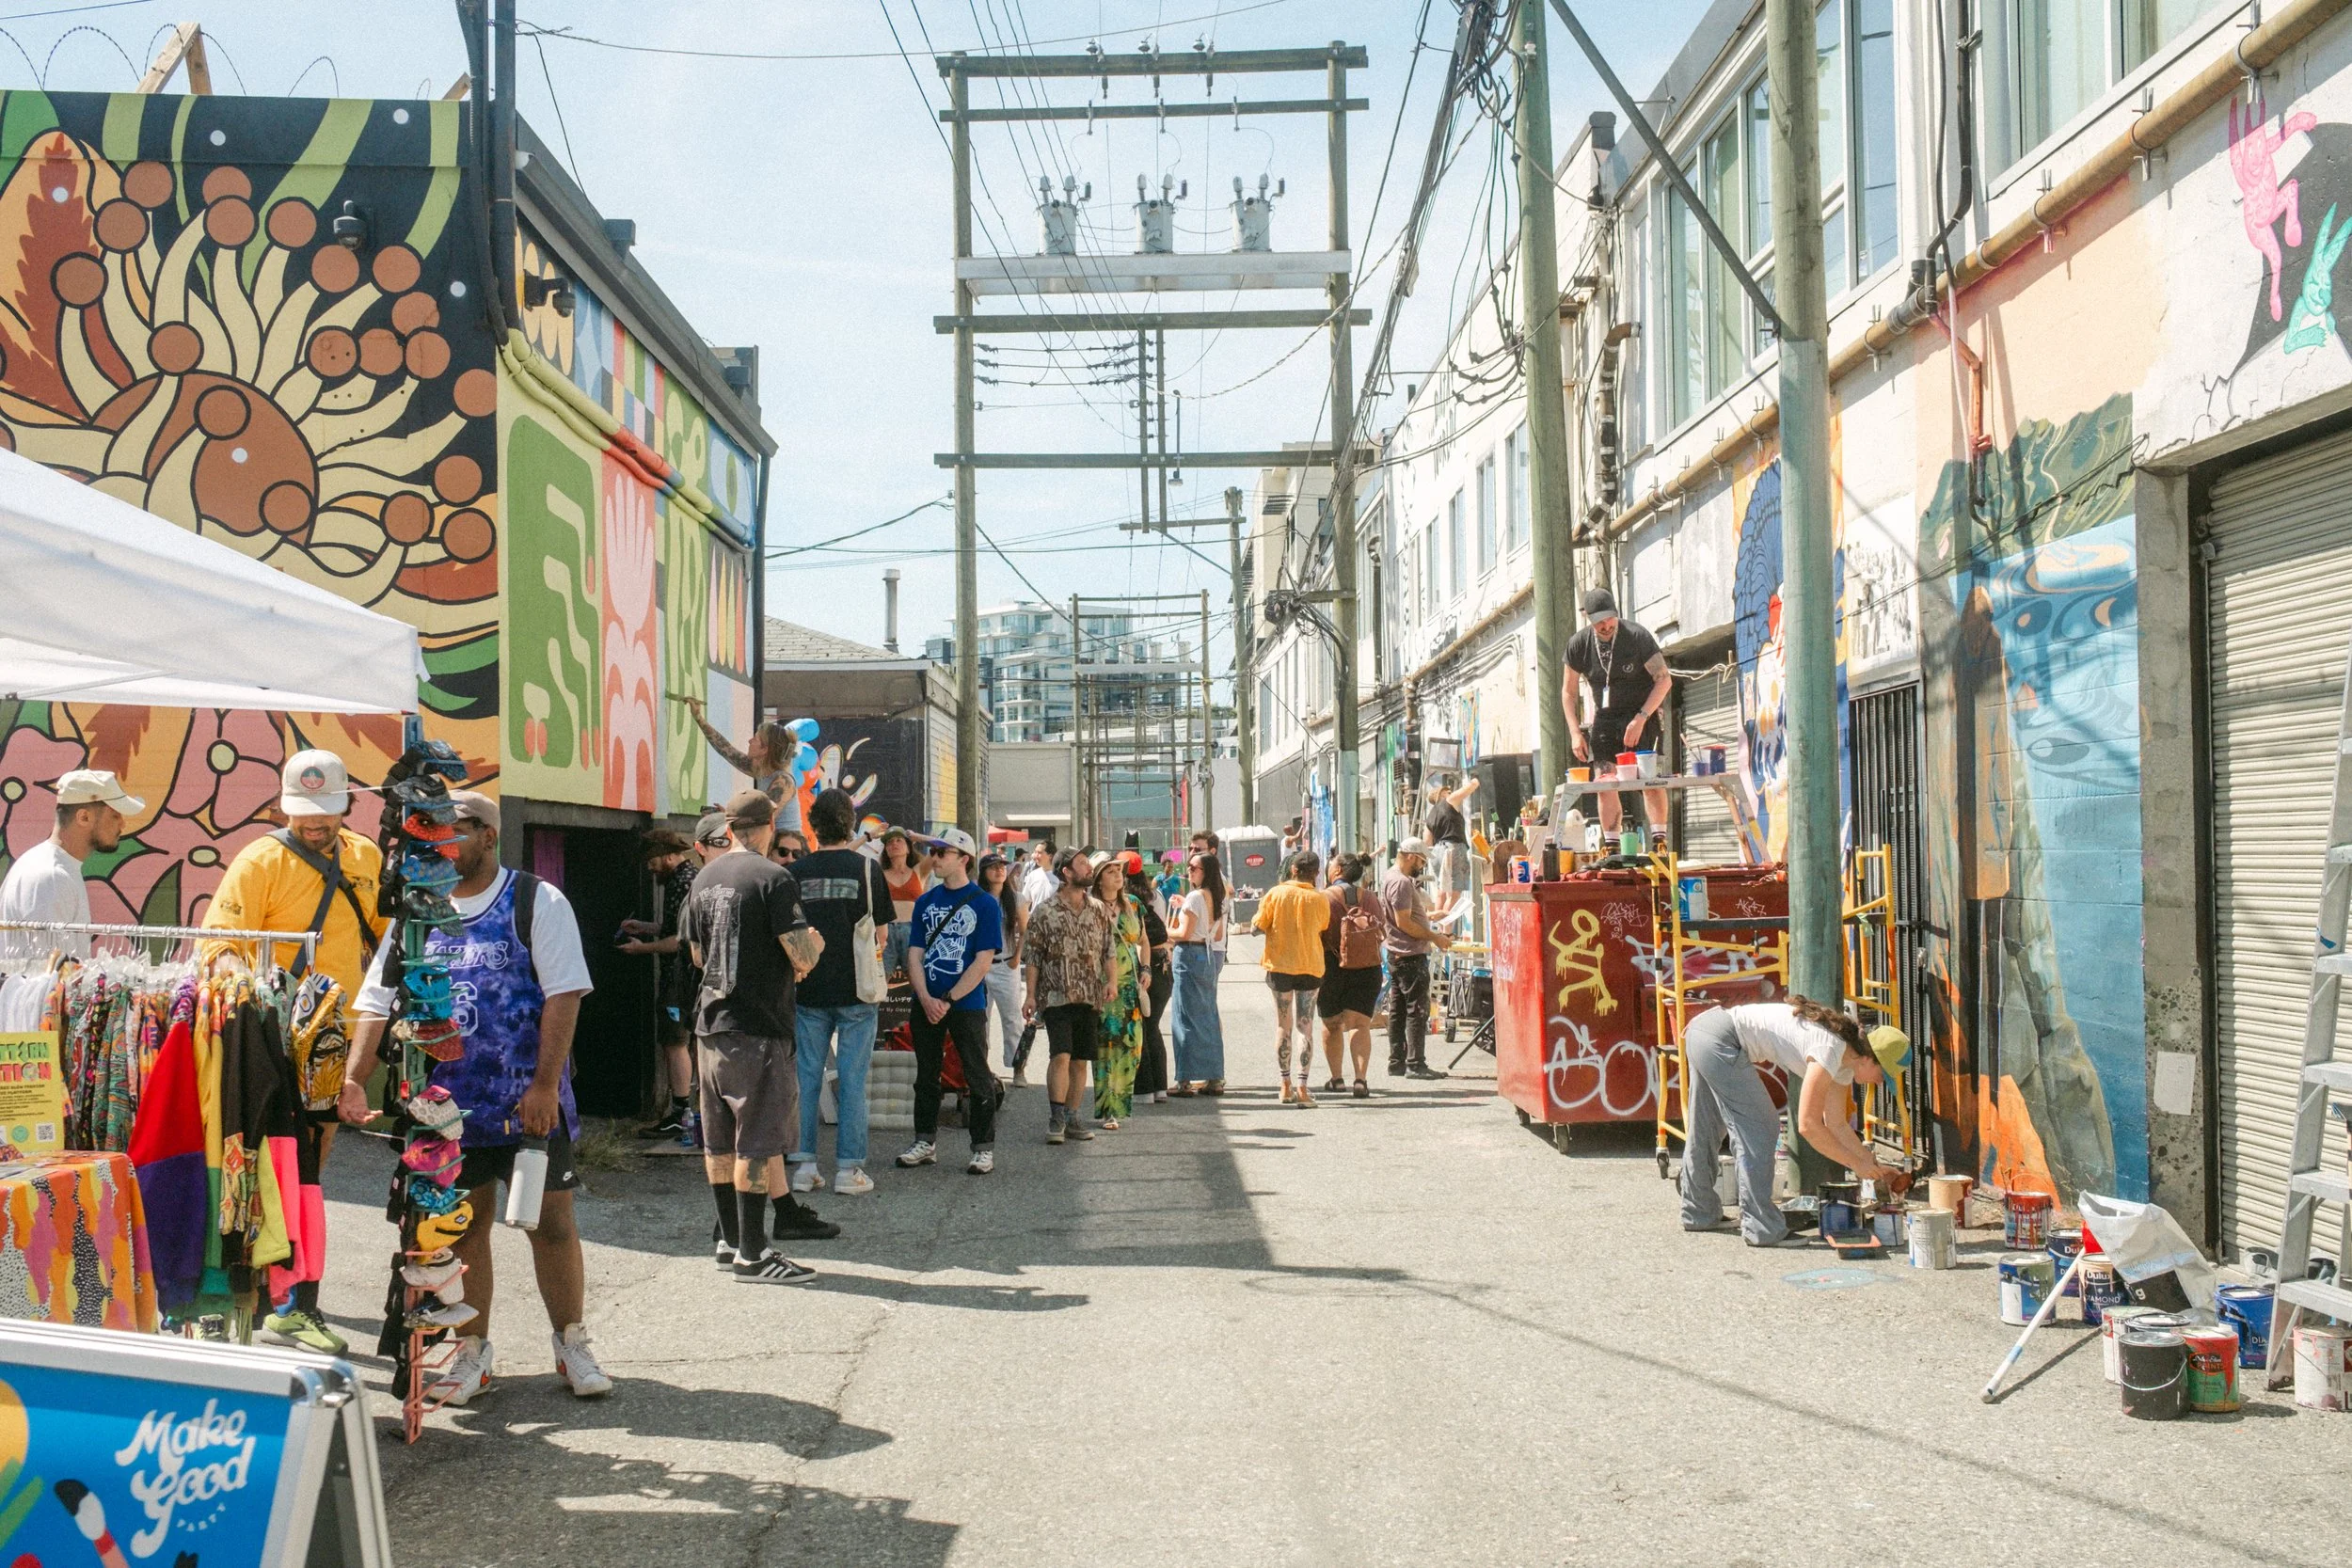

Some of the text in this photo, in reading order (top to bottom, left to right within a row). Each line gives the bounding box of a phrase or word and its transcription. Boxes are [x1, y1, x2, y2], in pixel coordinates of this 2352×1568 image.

[0, 1062, 53, 1082] TION
[115, 1398, 247, 1469] Make
[130, 1436, 257, 1559] Good
